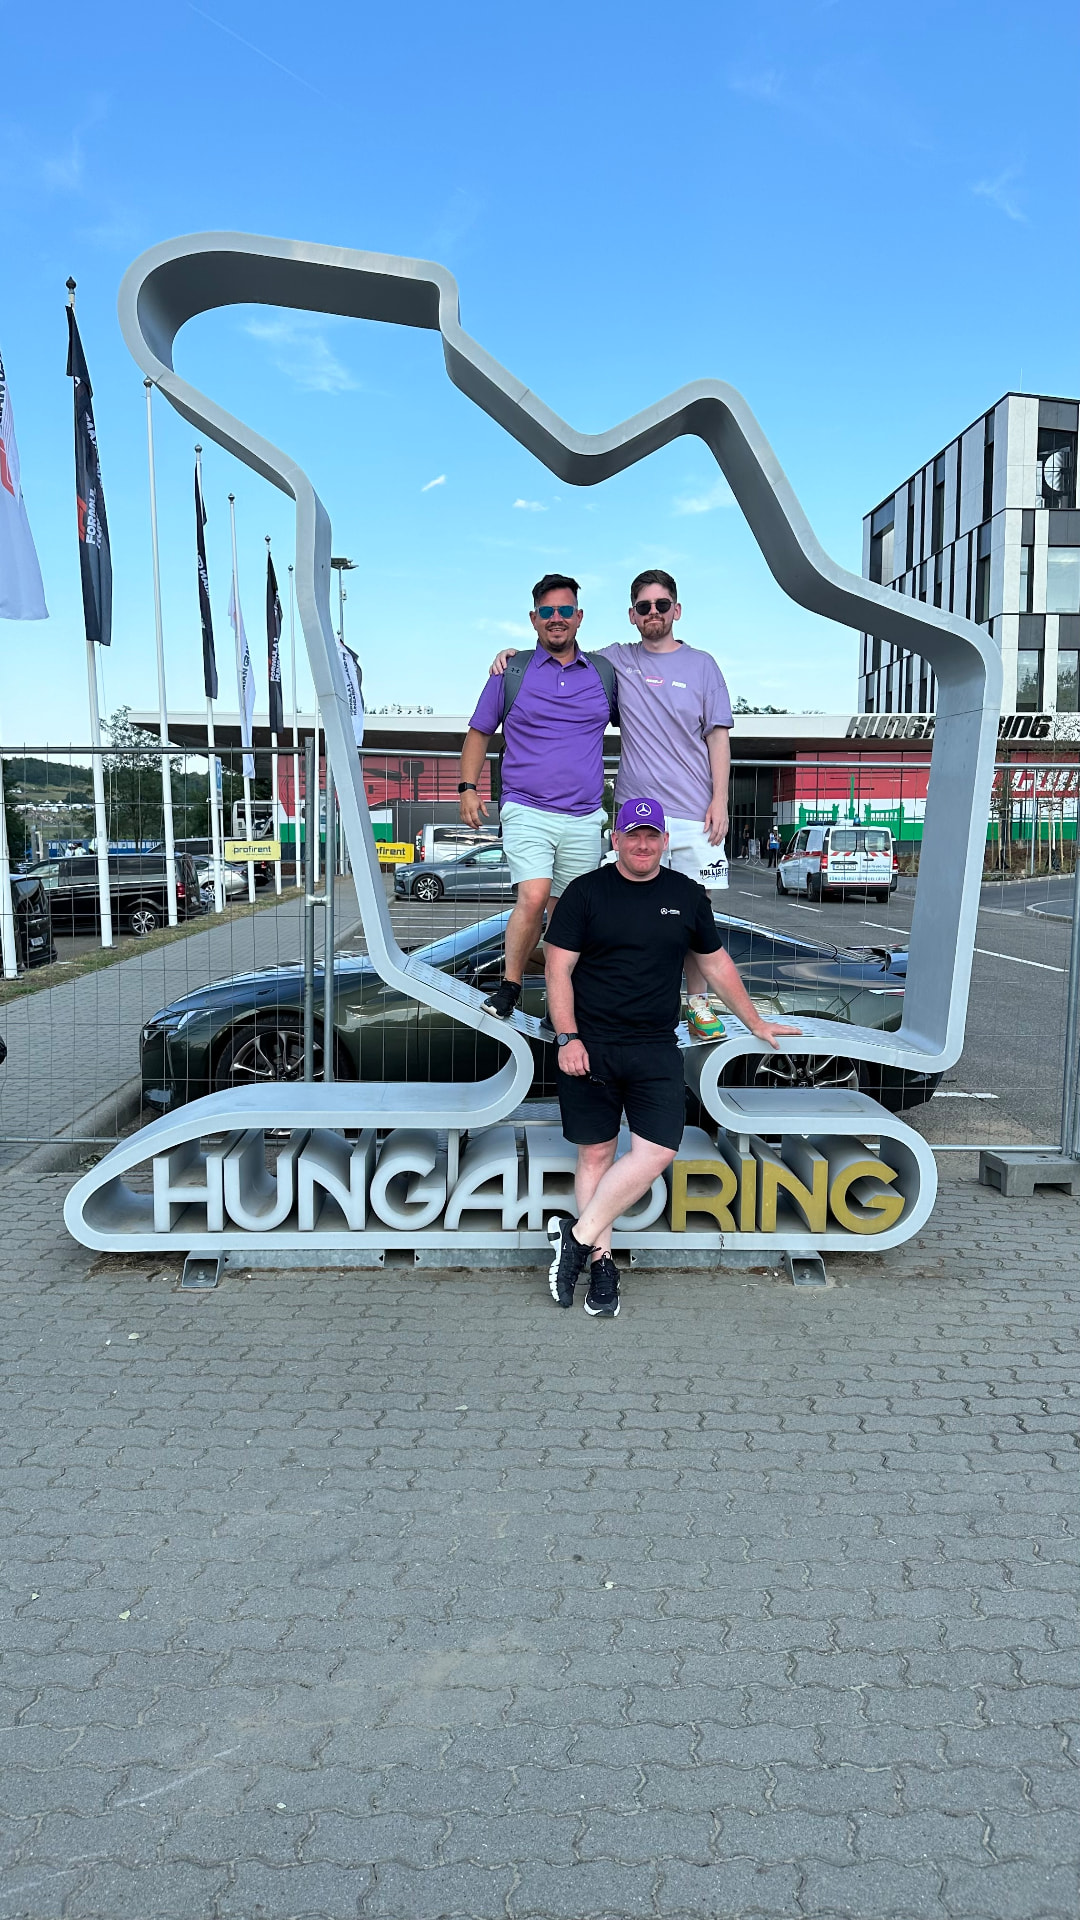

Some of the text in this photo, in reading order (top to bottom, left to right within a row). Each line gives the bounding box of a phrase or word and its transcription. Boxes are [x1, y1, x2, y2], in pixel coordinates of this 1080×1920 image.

[845, 716, 1053, 738] HUNGING
[233, 846, 271, 854] profirent
[376, 847, 406, 856] firent
[700, 867, 728, 877] HOLLIST
